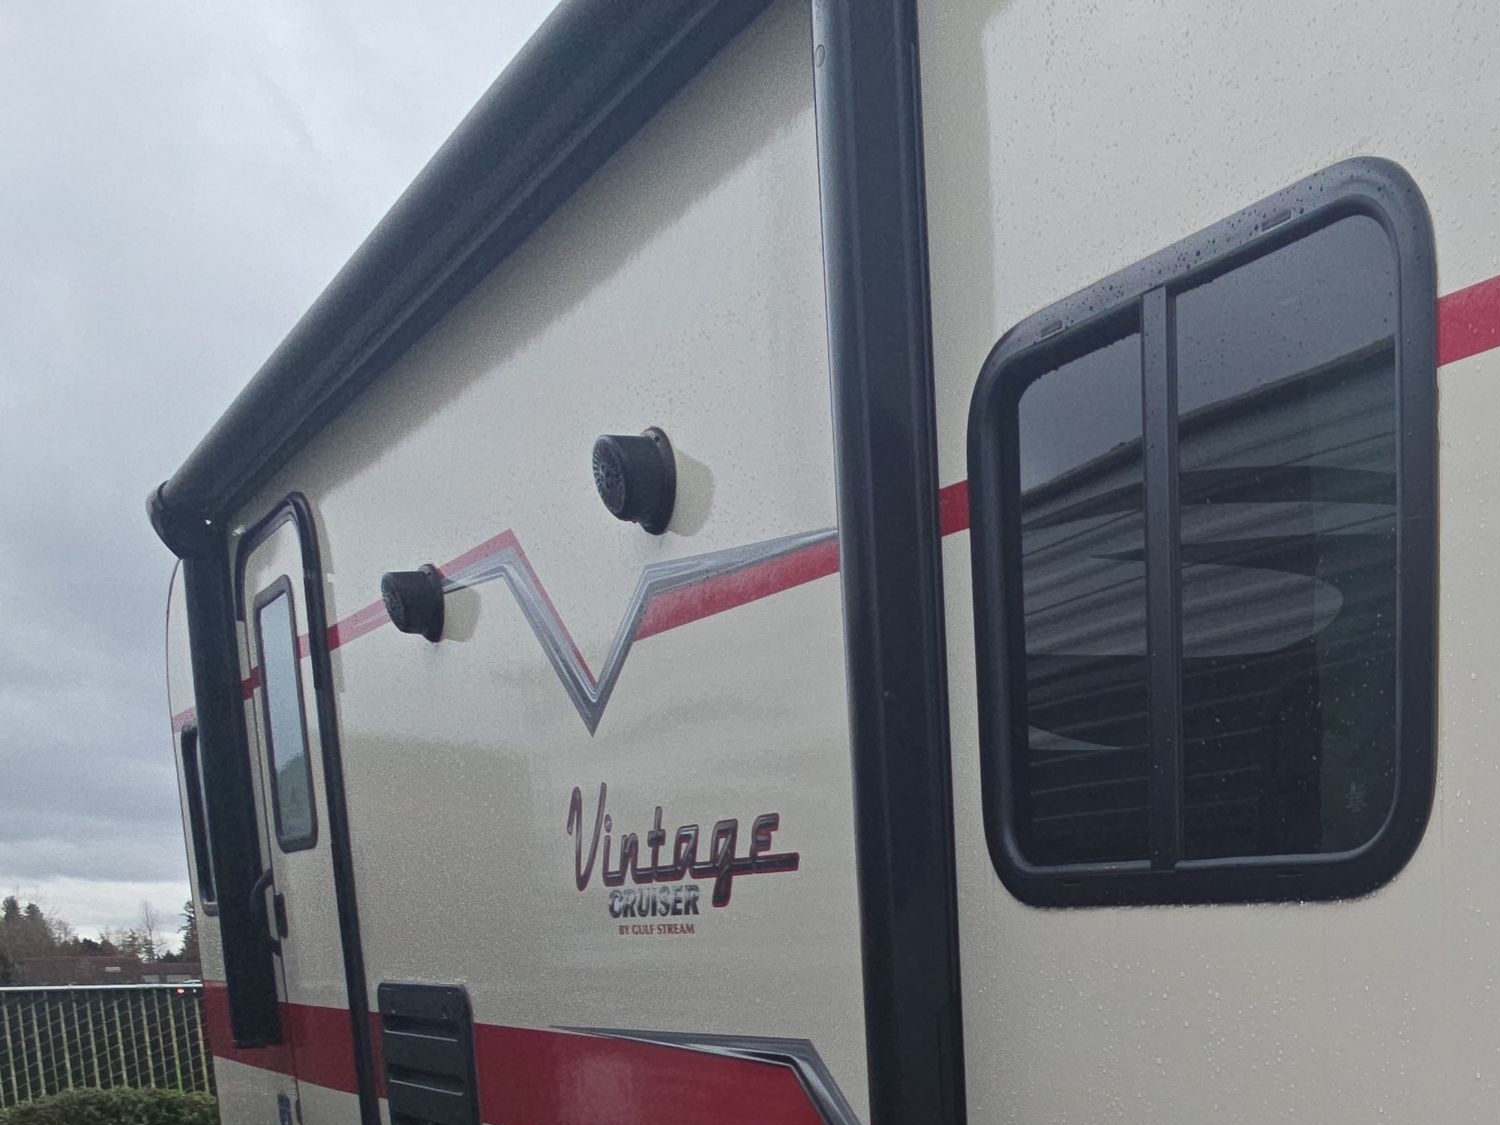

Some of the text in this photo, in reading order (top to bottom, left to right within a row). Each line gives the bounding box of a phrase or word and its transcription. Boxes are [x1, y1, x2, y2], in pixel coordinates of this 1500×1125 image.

[566, 782, 799, 907] Vintage
[608, 885, 699, 918] CRUISER
[619, 923, 695, 935] BY GULF STREAM
